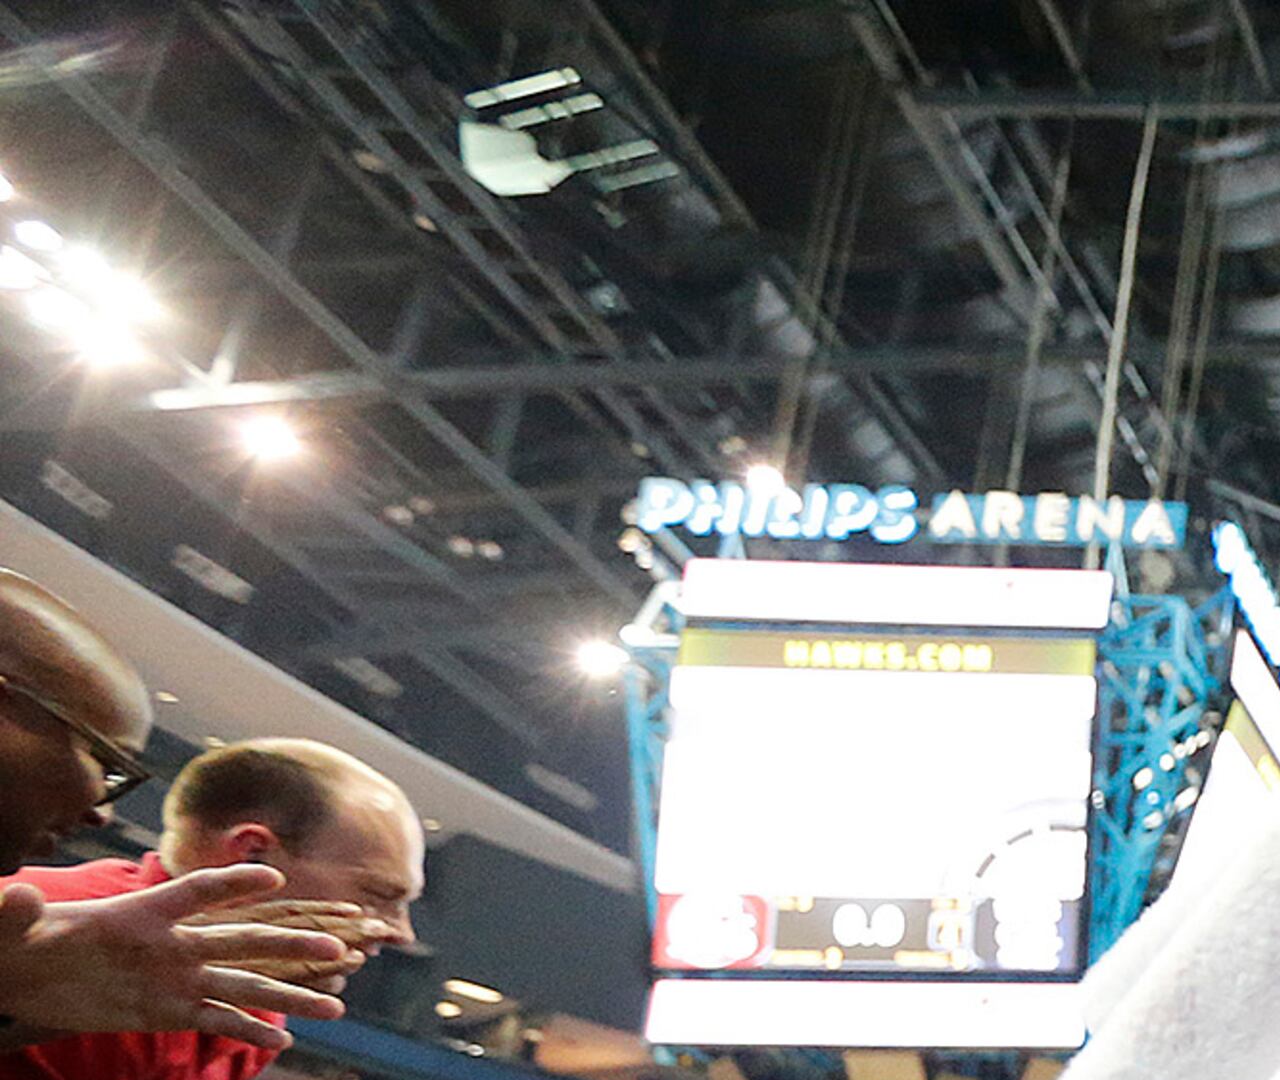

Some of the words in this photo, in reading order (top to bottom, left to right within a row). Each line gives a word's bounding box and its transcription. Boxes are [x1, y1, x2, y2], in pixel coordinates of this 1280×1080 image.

[637, 476, 919, 544] PHILIPS
[928, 489, 1178, 545] ARENA
[783, 640, 993, 672] HAWKS.COM
